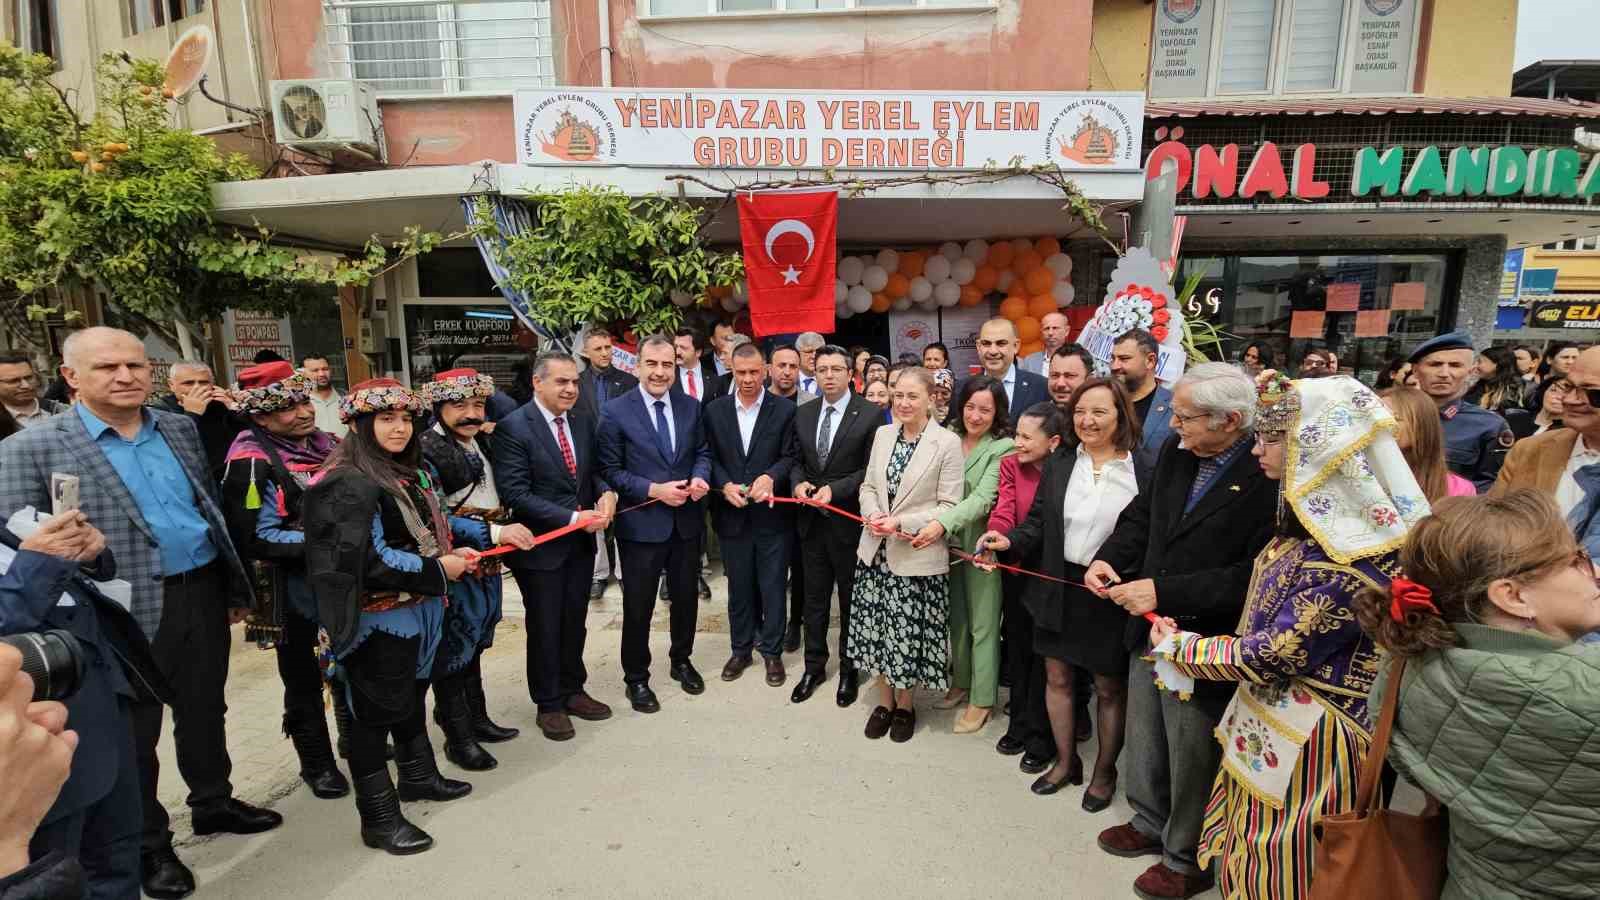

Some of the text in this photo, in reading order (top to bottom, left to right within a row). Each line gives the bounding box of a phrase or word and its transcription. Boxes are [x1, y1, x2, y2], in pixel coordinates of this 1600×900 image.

[535, 97, 557, 113] YEREL
[558, 94, 583, 103] EYLEM
[585, 99, 608, 121] GRUBU
[614, 93, 1040, 130] YENİPAZAR YEREL EYLEM
[1059, 101, 1080, 118] YEREL
[1081, 98, 1106, 107] EYLEM
[1107, 103, 1128, 126] GRUBU
[693, 130, 965, 168] GRUBU DERNEĞİ
[1145, 126, 1330, 199] ÖNAL
[433, 319, 462, 331] ERKEK
